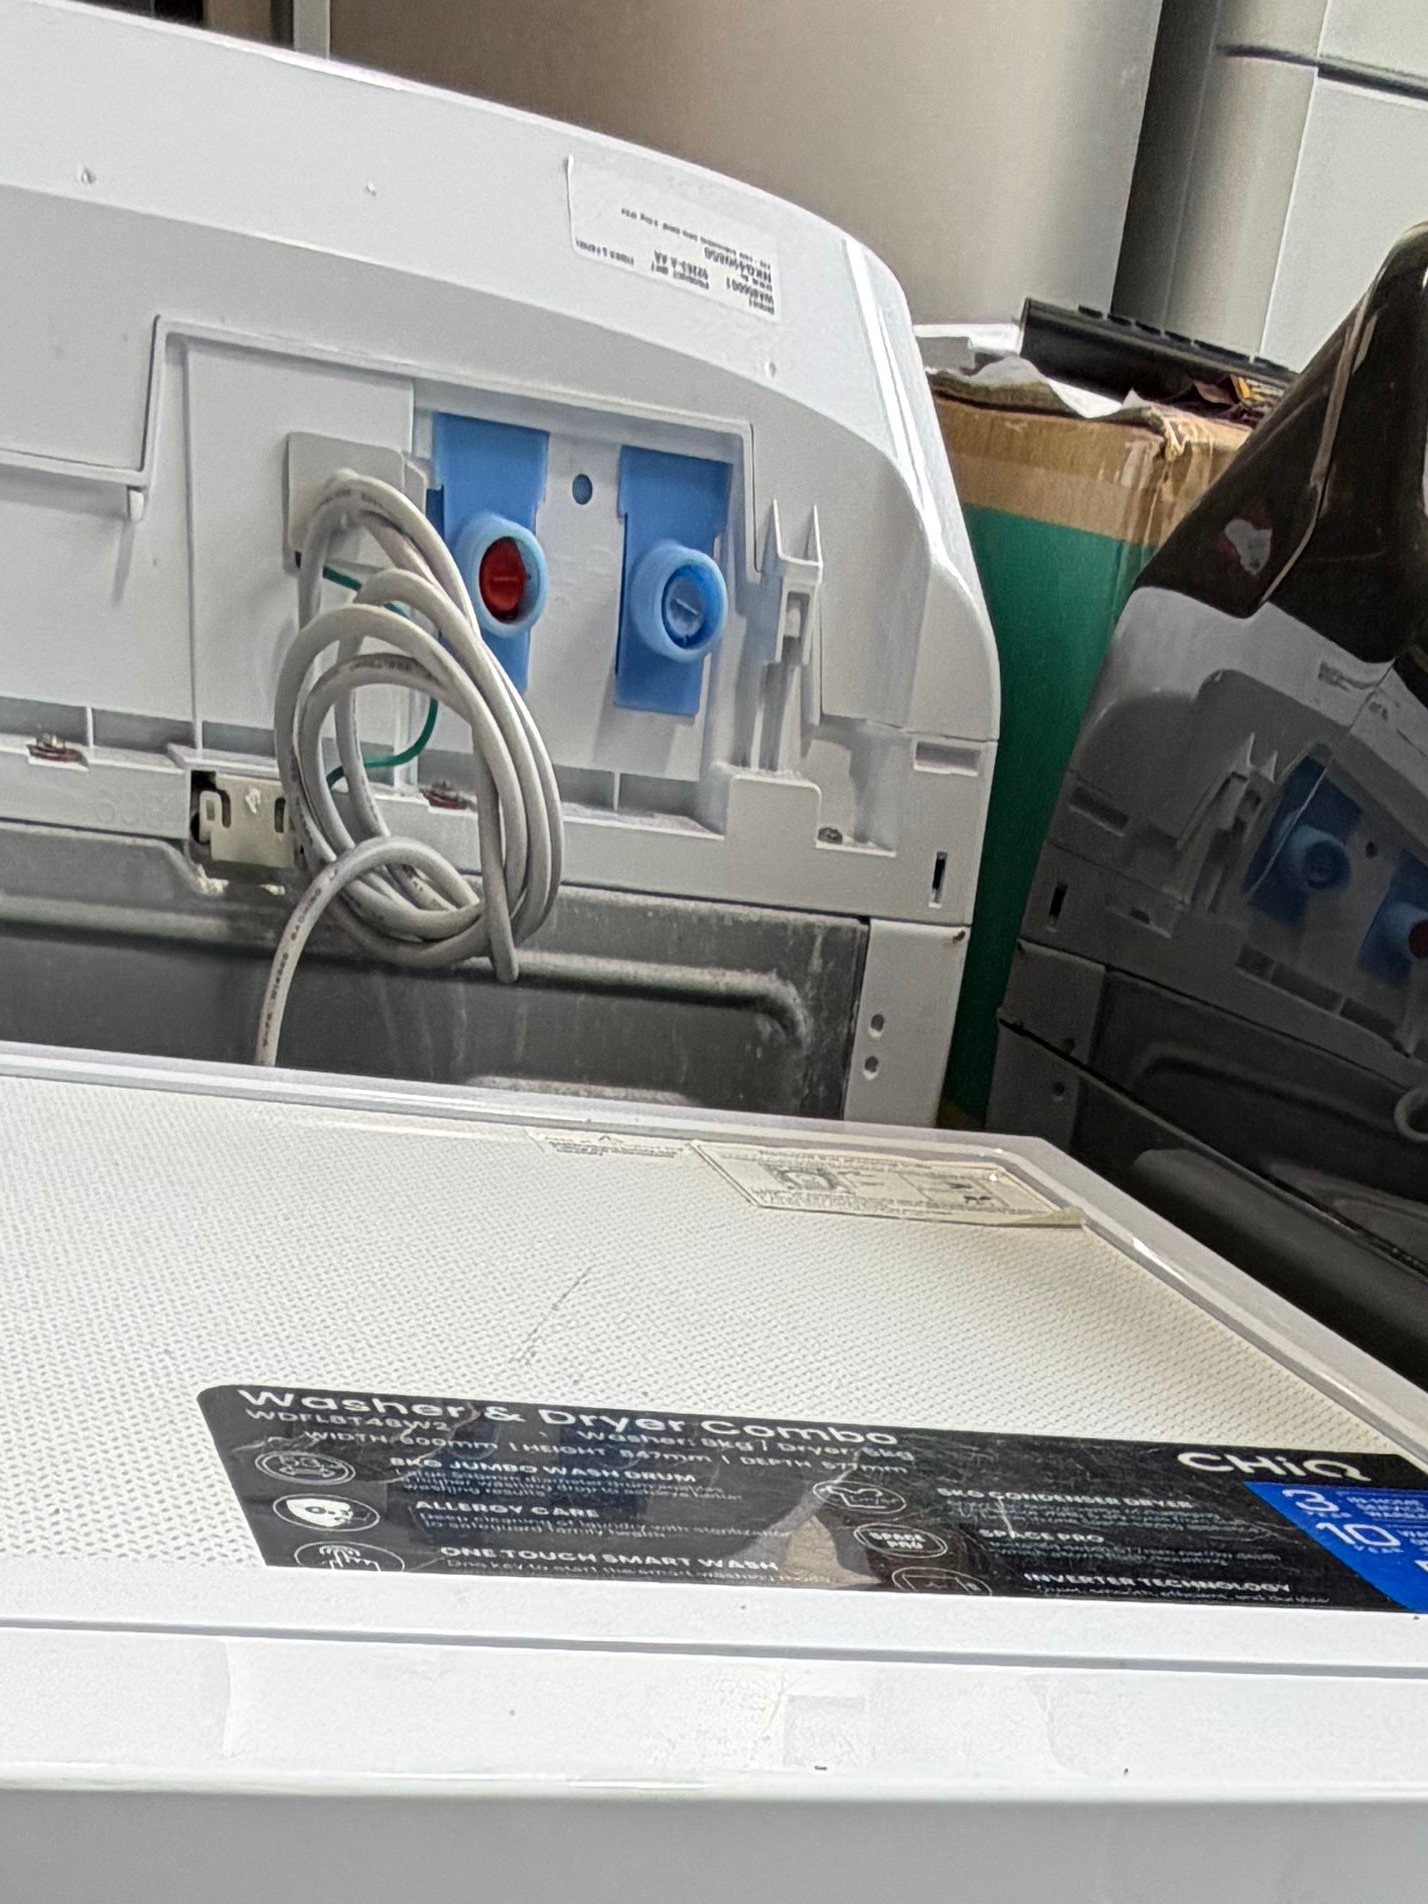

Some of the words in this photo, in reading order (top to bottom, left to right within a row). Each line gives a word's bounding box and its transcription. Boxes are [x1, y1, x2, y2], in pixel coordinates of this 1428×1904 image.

[237, 1389, 465, 1419] Washer
[484, 1405, 527, 1422] &
[539, 1408, 686, 1434] Dryer
[700, 1420, 898, 1445] Combo
[303, 1431, 387, 1444] WIDTH
[740, 1456, 812, 1468] DEPTH
[449, 1461, 538, 1474] JUMBO
[542, 1465, 619, 1479] WASH
[624, 1470, 697, 1483] DRUM
[1176, 1451, 1372, 1482] CHiQ
[415, 1500, 523, 1515] ALLERGY
[530, 1506, 600, 1518] CARE
[1281, 1488, 1340, 1513] 3
[1314, 1522, 1402, 1547] 10
[440, 1546, 498, 1559] ONE
[499, 1549, 598, 1564] TOUCH
[601, 1553, 691, 1567] SMART
[698, 1558, 779, 1571] WASH
[1137, 1576, 1291, 1593] TECHNOLOGY
